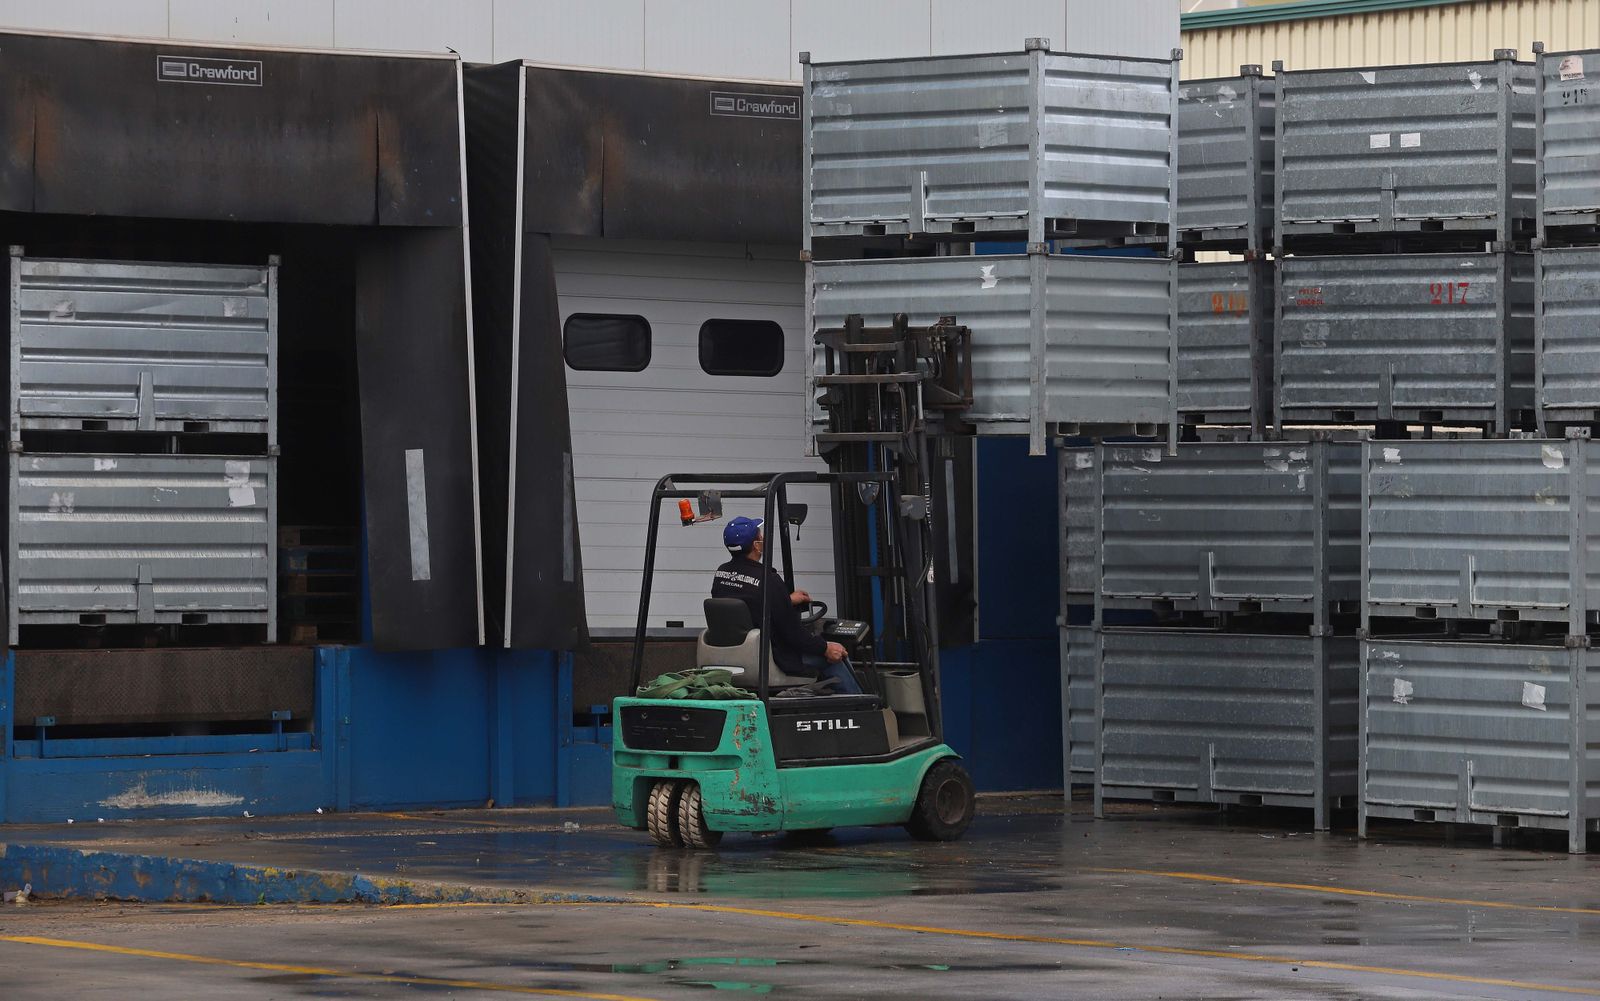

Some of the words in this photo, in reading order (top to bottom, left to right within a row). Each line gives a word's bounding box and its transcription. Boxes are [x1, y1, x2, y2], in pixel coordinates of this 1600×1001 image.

[190, 63, 257, 81] Crawford
[737, 98, 796, 115] Crawford
[1430, 280, 1470, 304] 217
[796, 718, 861, 731] STILL
